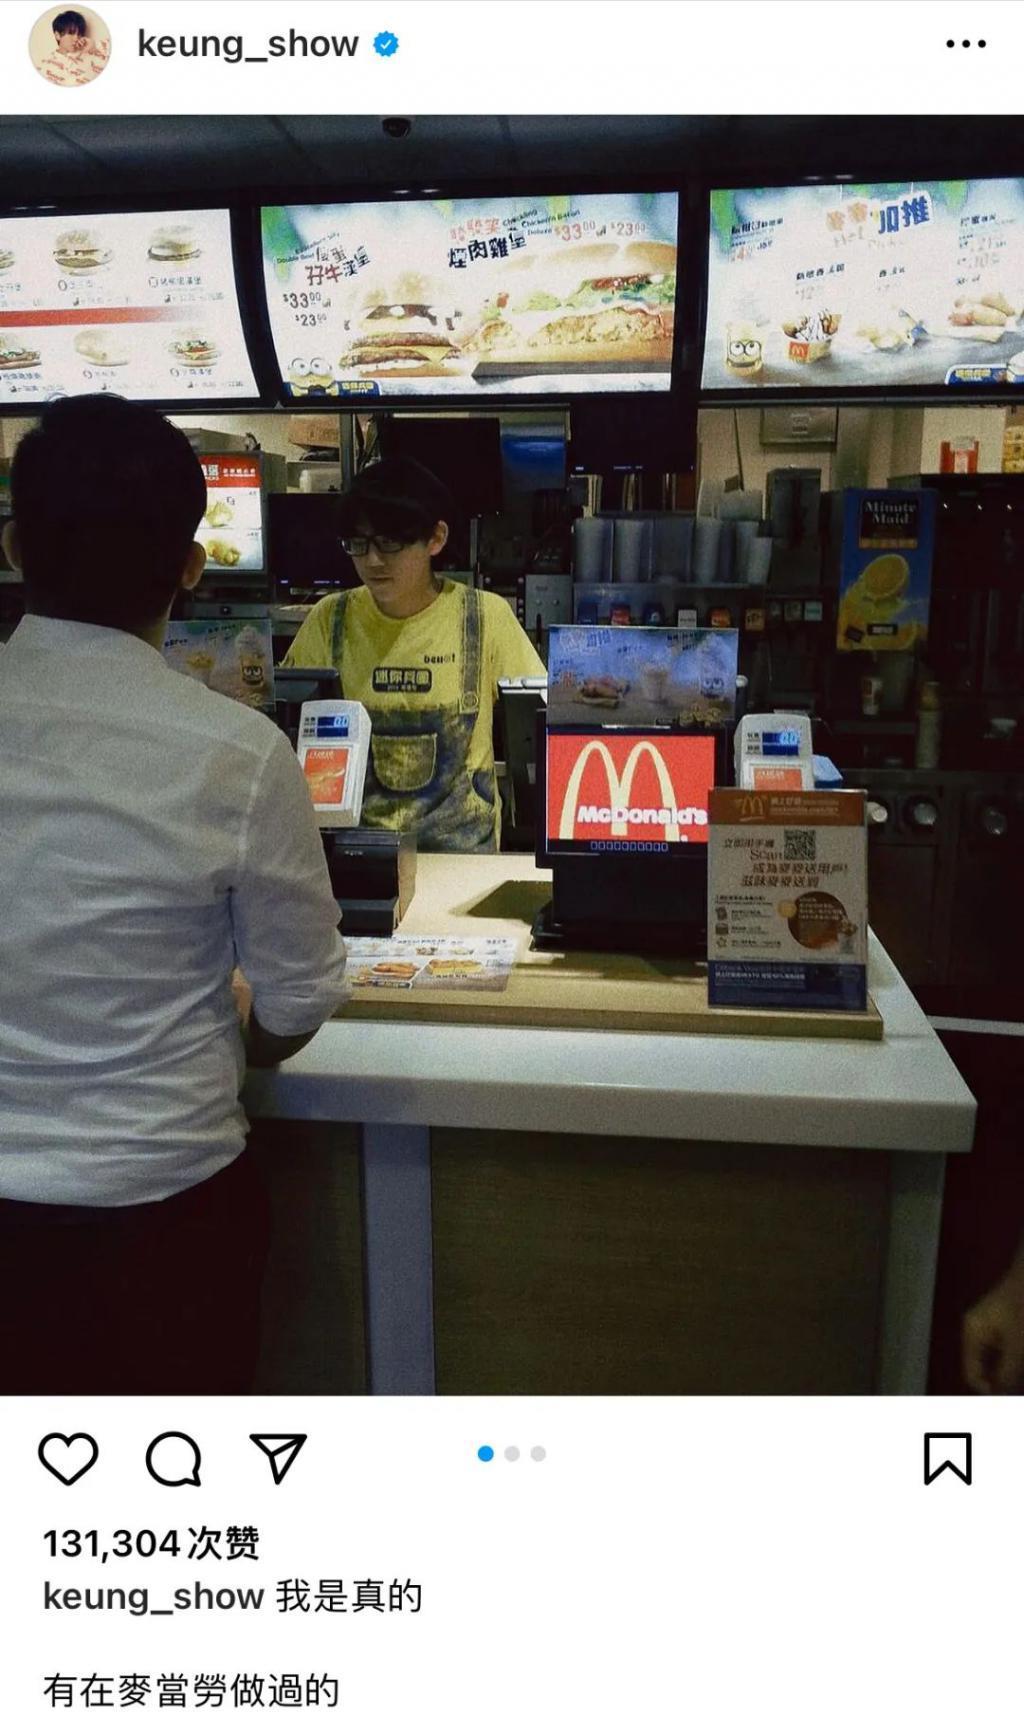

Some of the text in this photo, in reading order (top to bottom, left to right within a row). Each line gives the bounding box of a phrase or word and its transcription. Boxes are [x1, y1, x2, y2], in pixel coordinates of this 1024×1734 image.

[865, 501, 916, 513] Minute
[873, 513, 909, 524] Maid
[577, 806, 708, 825] McDonald's
[750, 850, 783, 861] Scan
